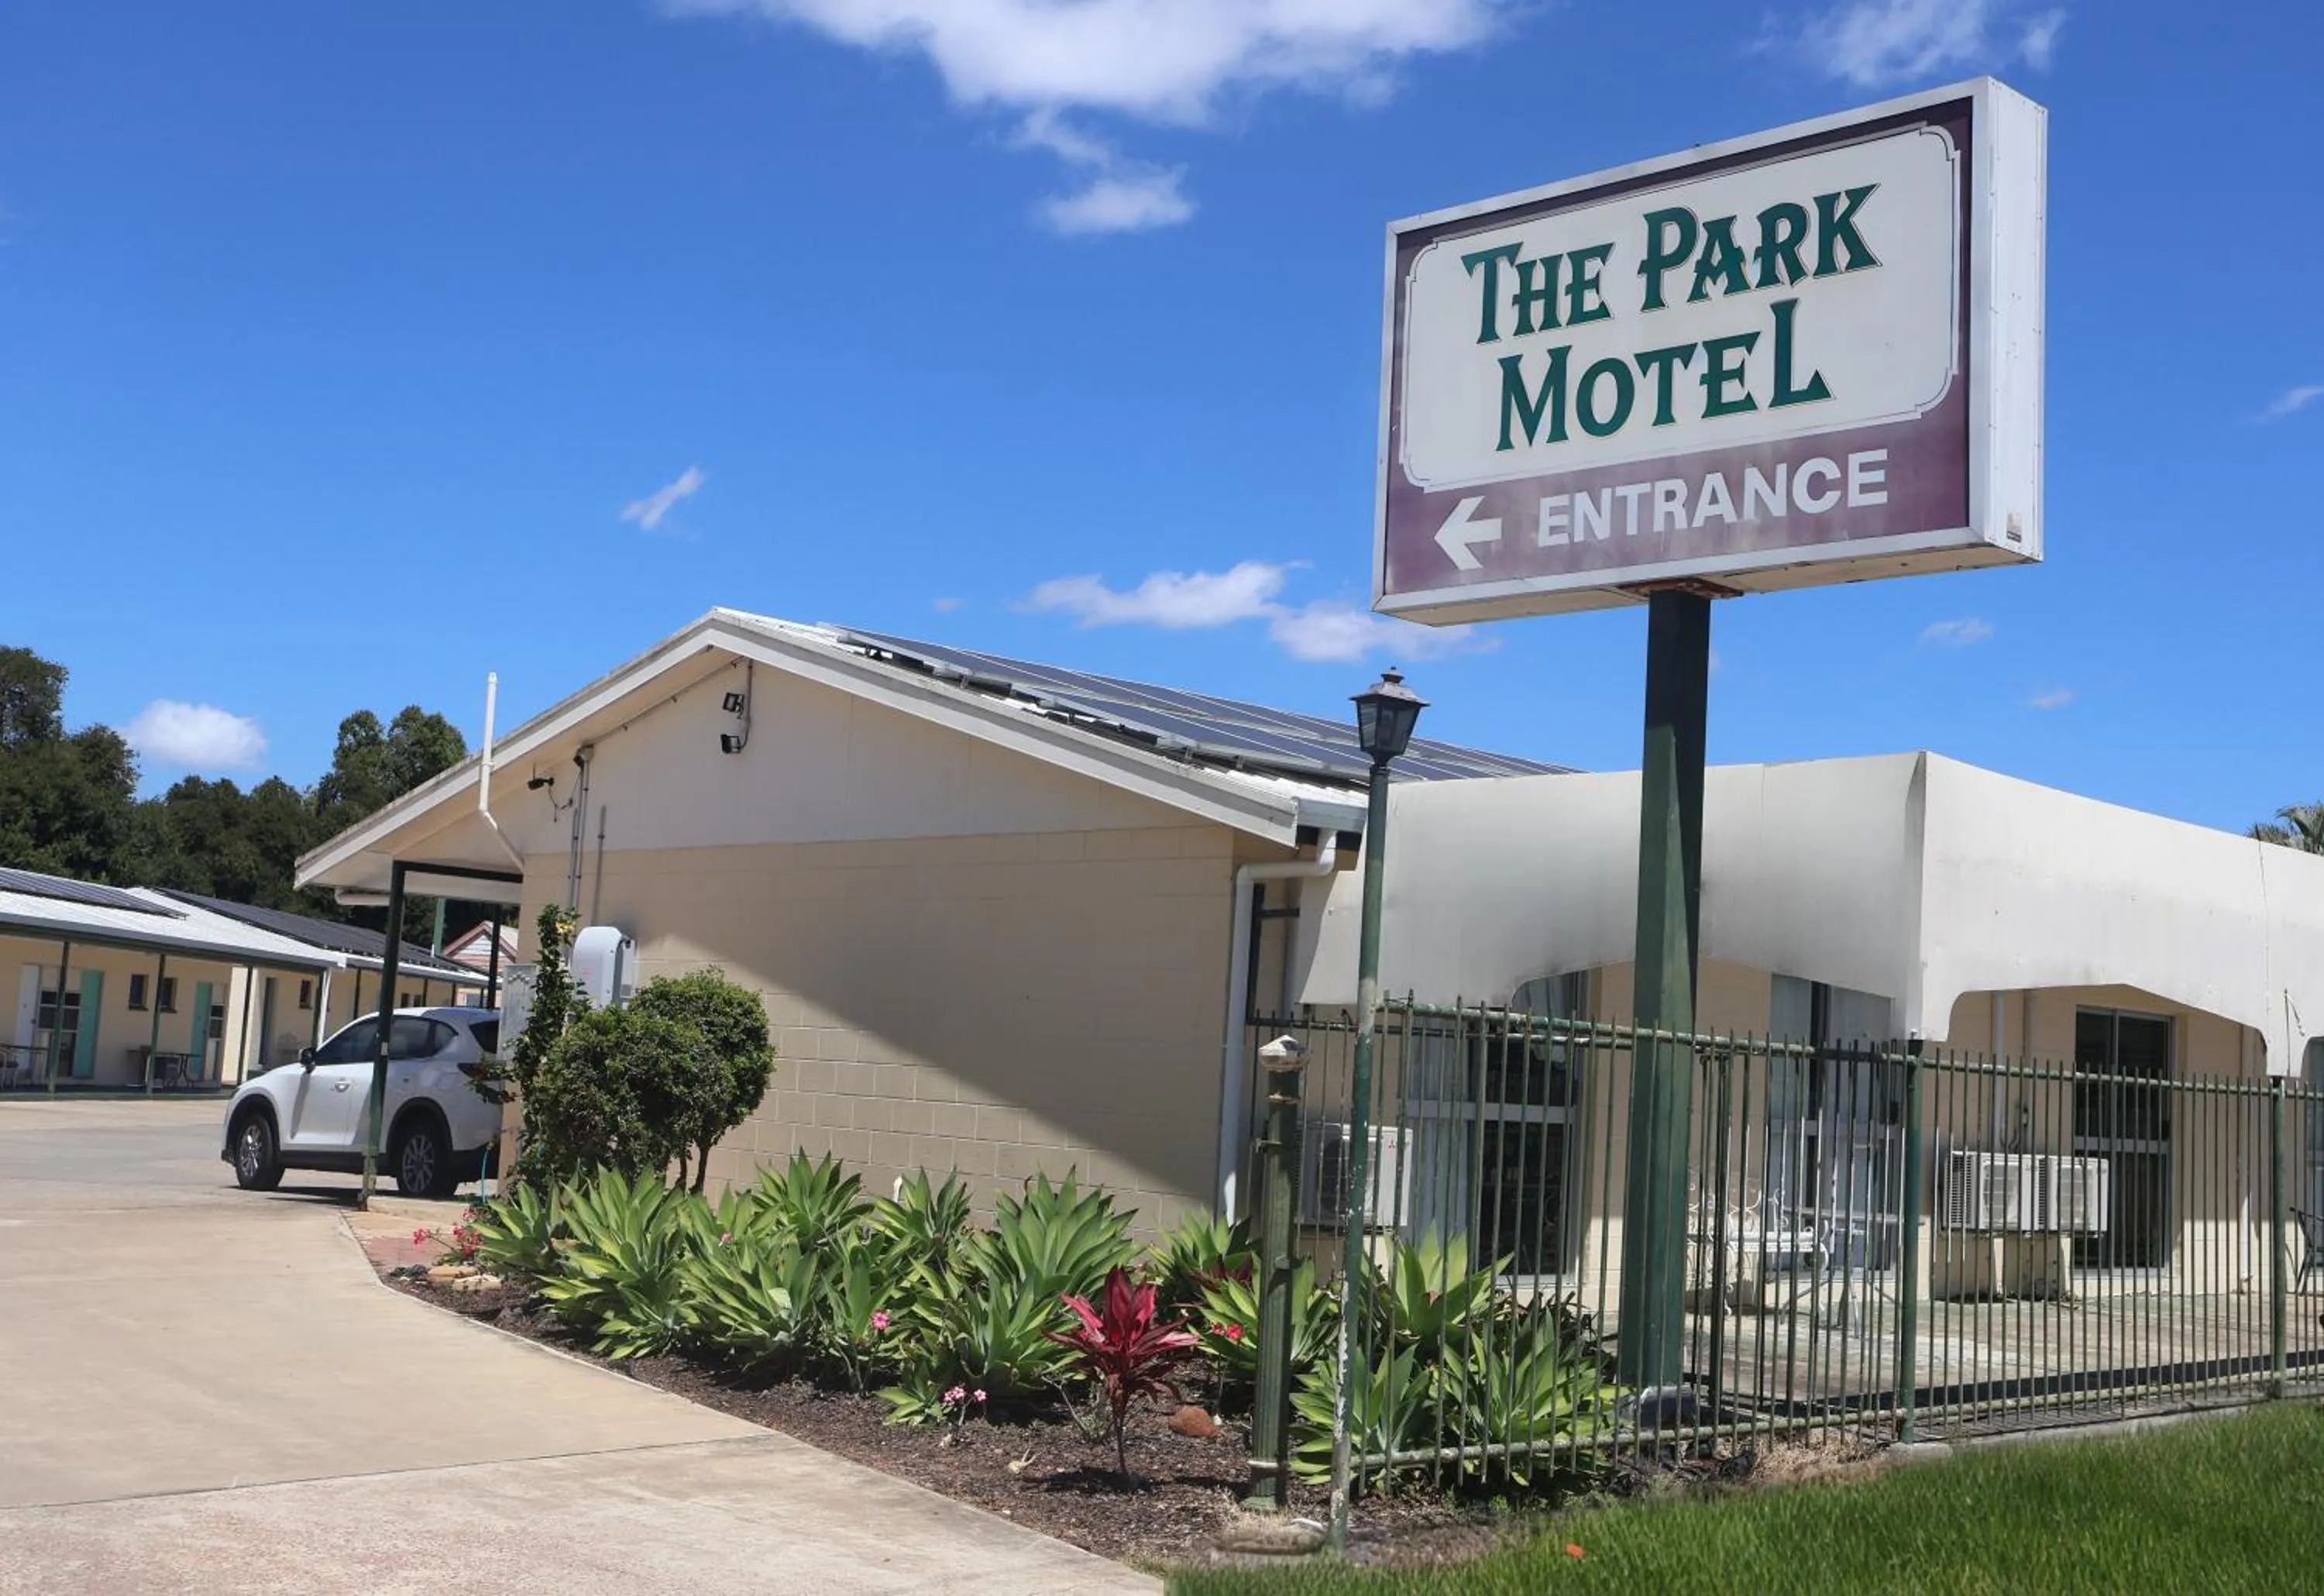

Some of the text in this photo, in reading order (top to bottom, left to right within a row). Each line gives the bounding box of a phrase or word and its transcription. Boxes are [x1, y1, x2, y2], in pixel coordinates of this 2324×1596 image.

[1461, 183, 1882, 344] THE PARK
[1496, 298, 1834, 452] MOTEL
[1537, 449, 1889, 548] ENTRANCE
